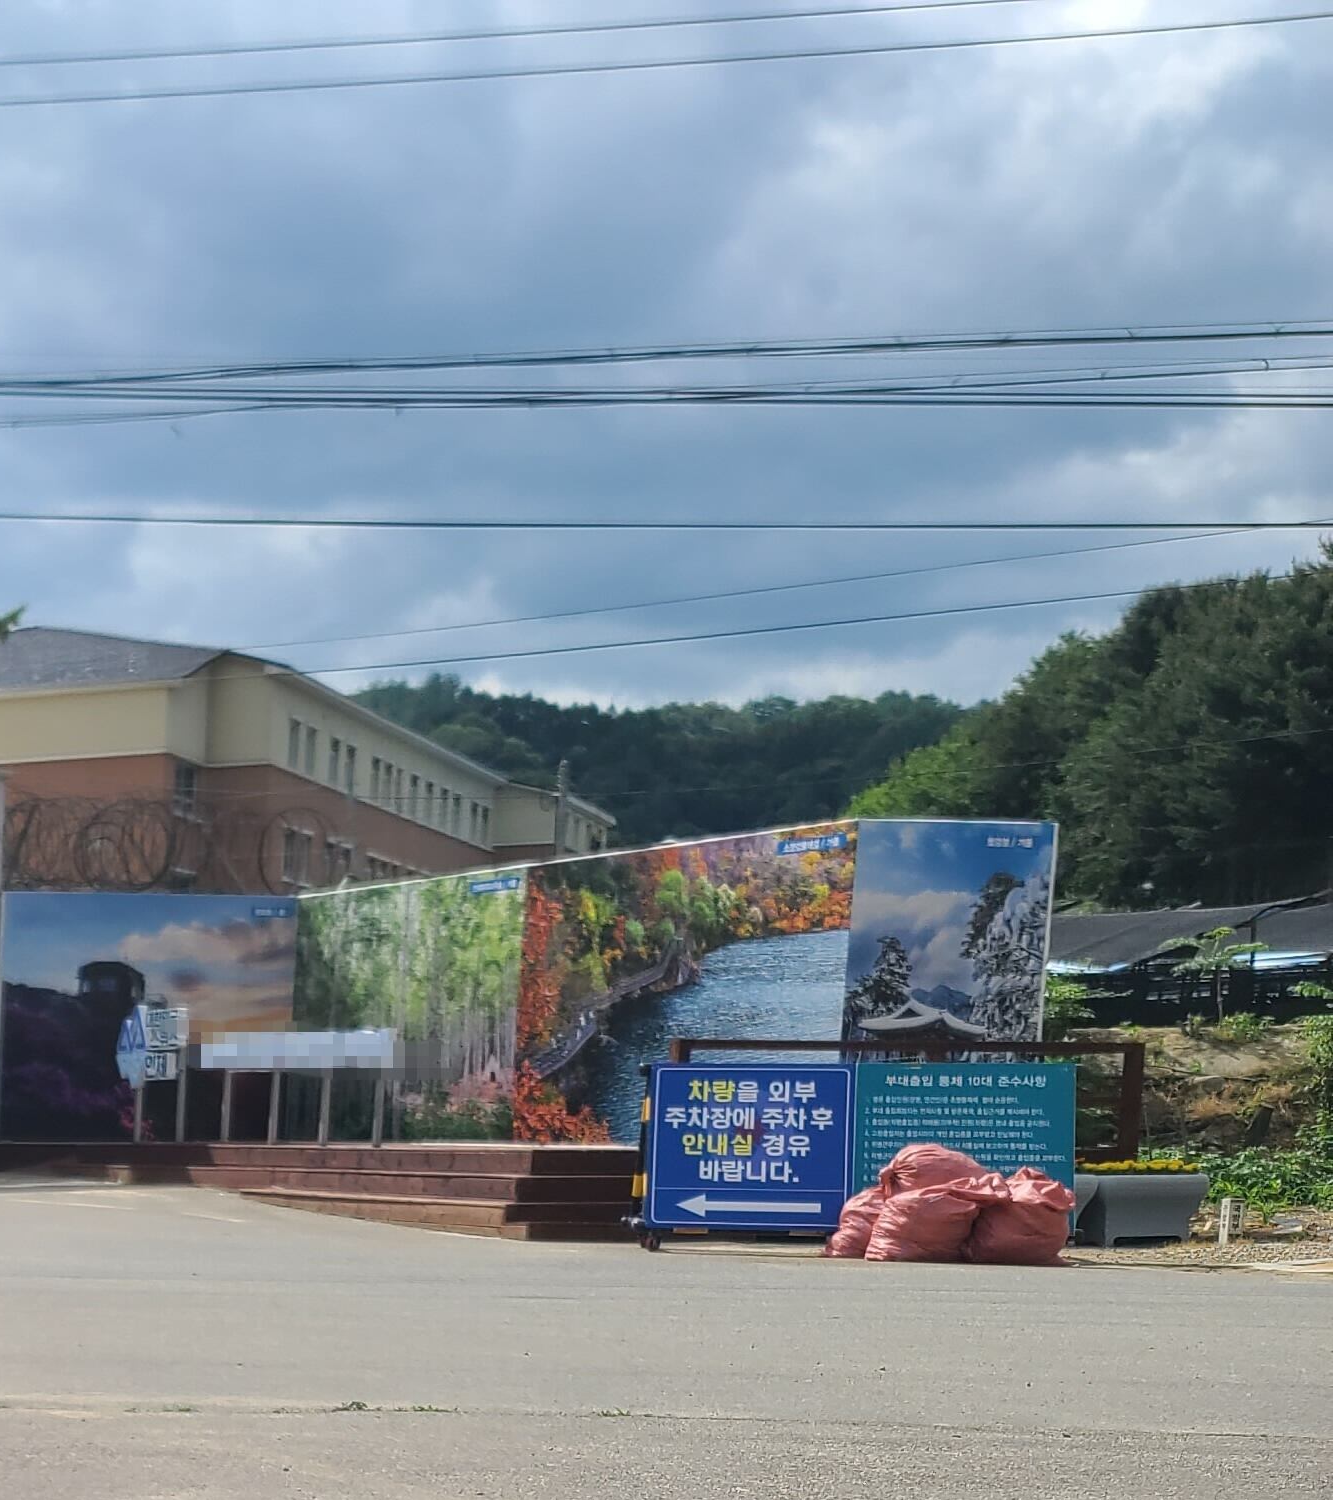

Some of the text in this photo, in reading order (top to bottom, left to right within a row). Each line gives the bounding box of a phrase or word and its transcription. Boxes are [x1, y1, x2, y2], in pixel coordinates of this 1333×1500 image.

[688, 1080, 817, 1104] 차량을 외부
[967, 1075, 993, 1088] 10대
[664, 1107, 834, 1131] 주차장에 주차 후
[682, 1133, 811, 1157] 안내실 경유
[698, 1160, 800, 1183] 바랍니다.
